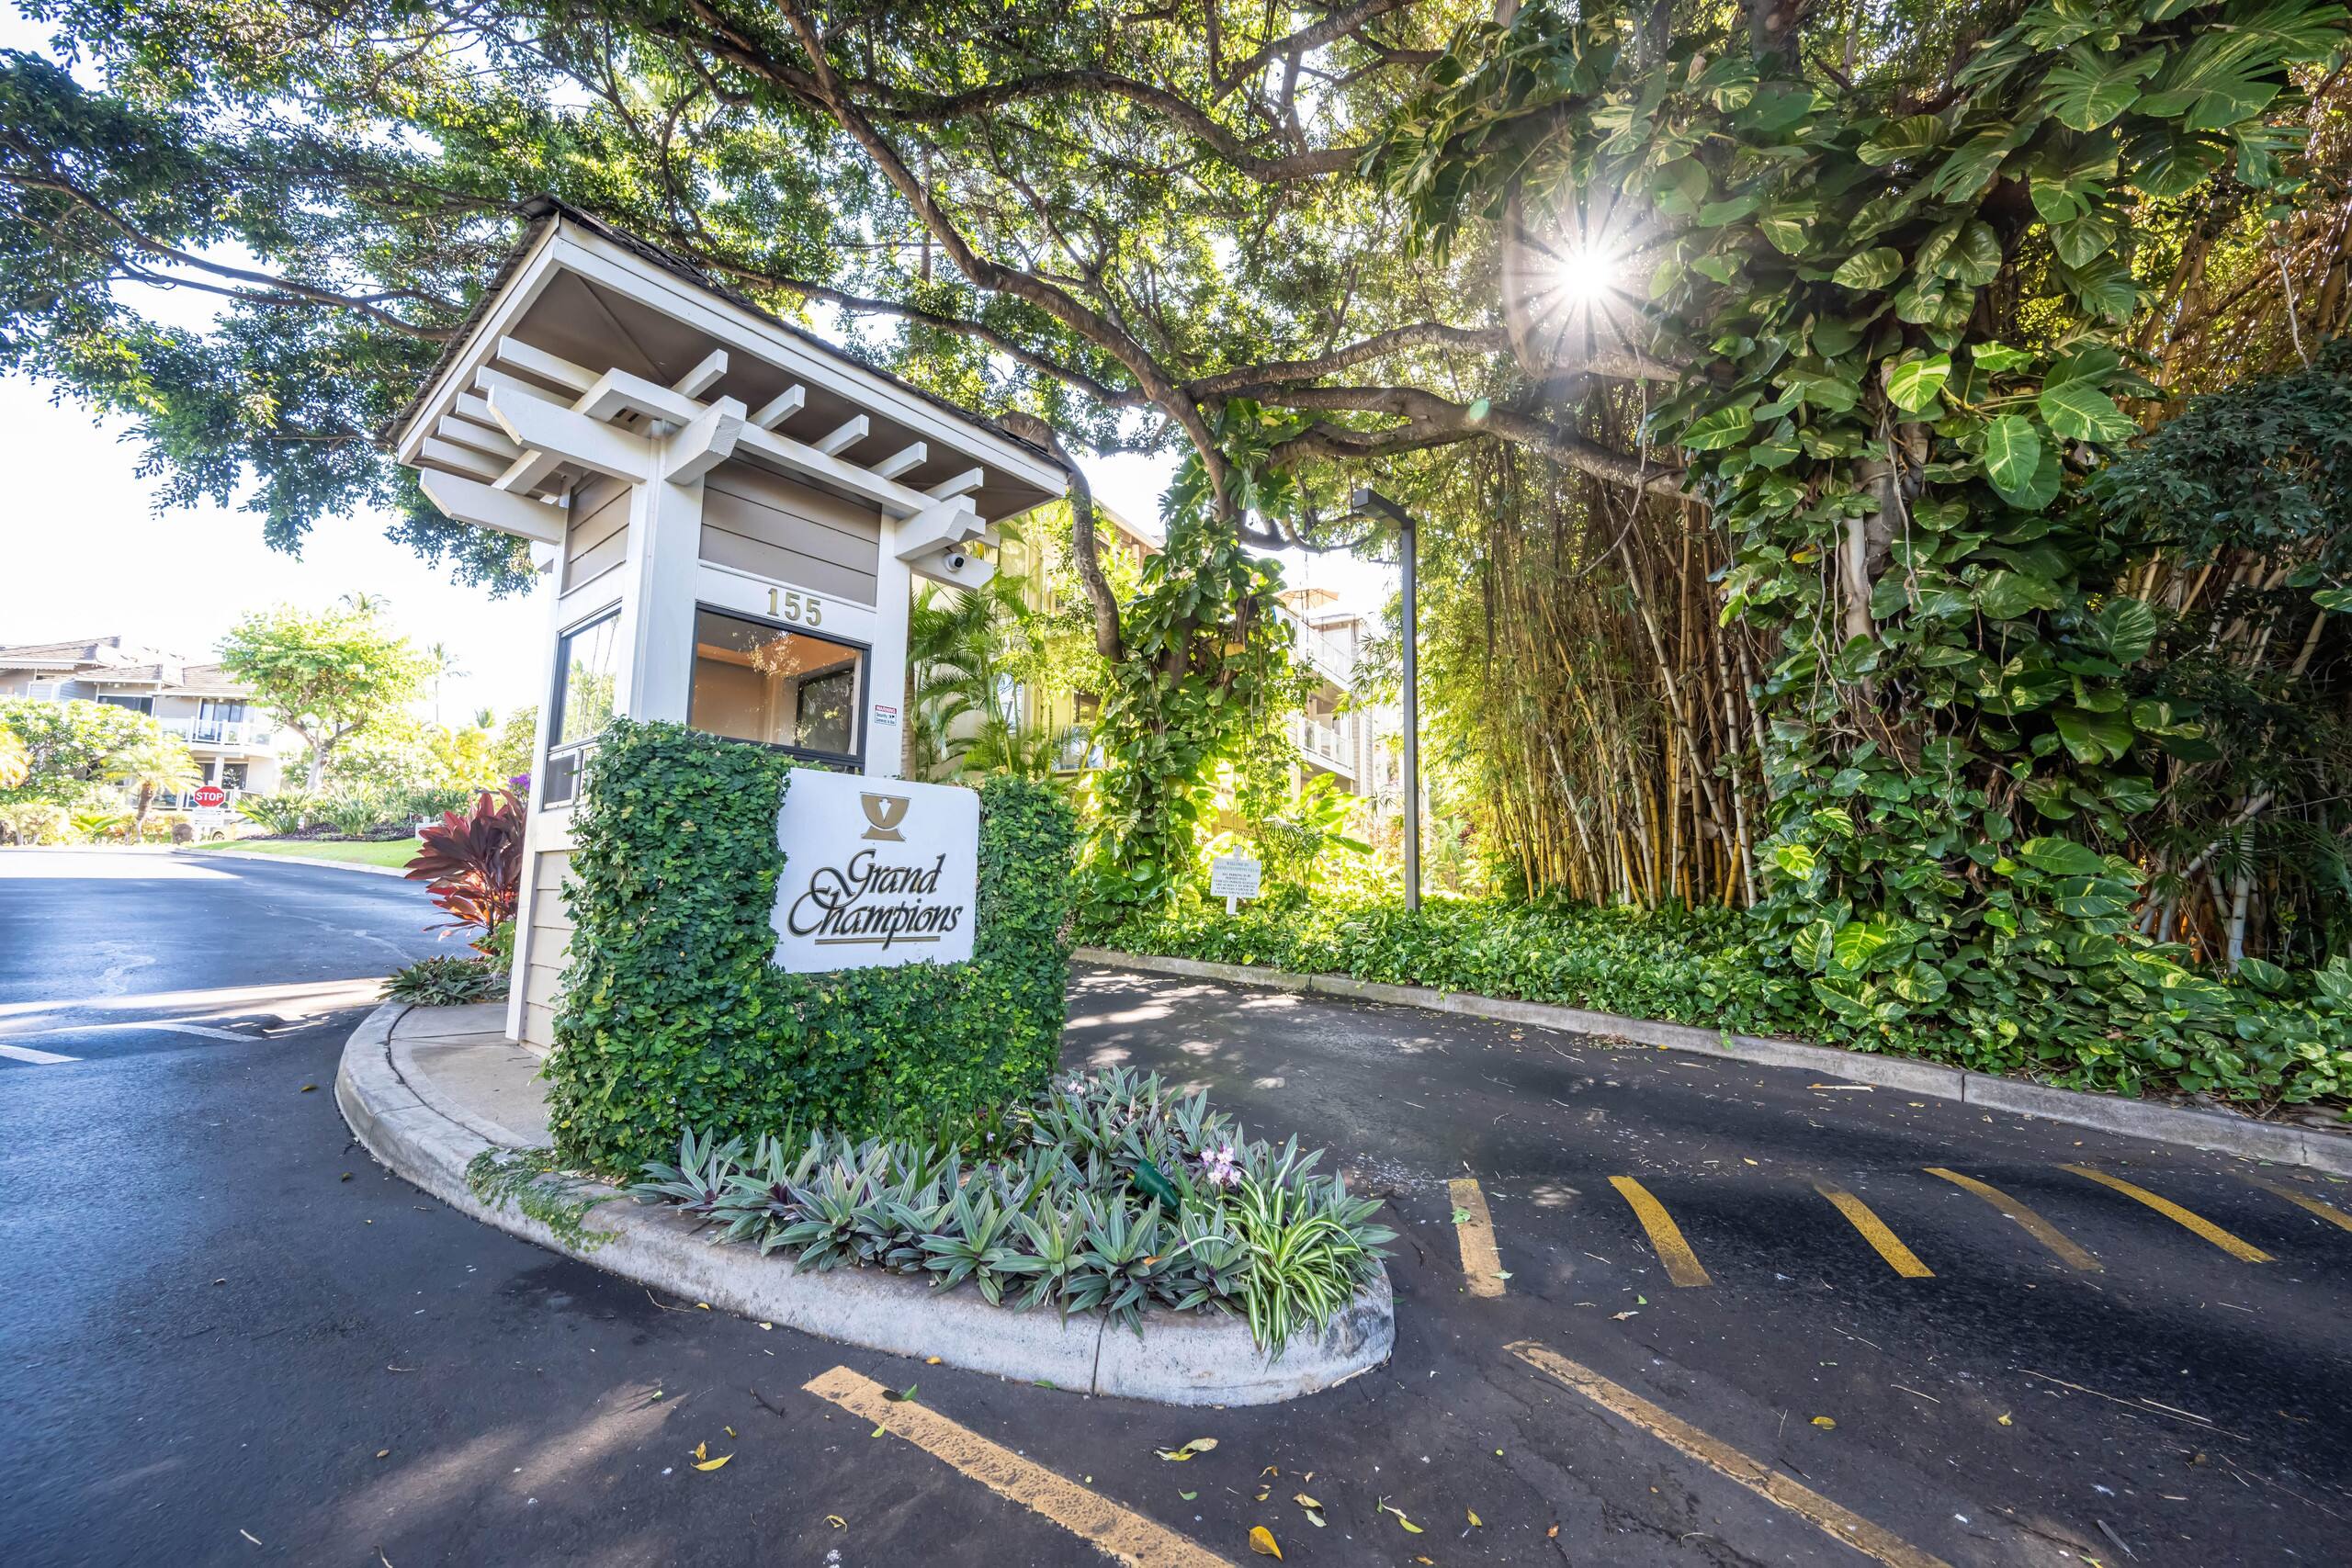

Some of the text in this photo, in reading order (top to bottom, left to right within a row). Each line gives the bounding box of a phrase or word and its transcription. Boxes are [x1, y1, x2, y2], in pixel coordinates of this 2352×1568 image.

[767, 588, 821, 626] 155
[196, 792, 223, 801] STOP
[809, 849, 946, 909] Grand
[787, 886, 964, 951] Champions
